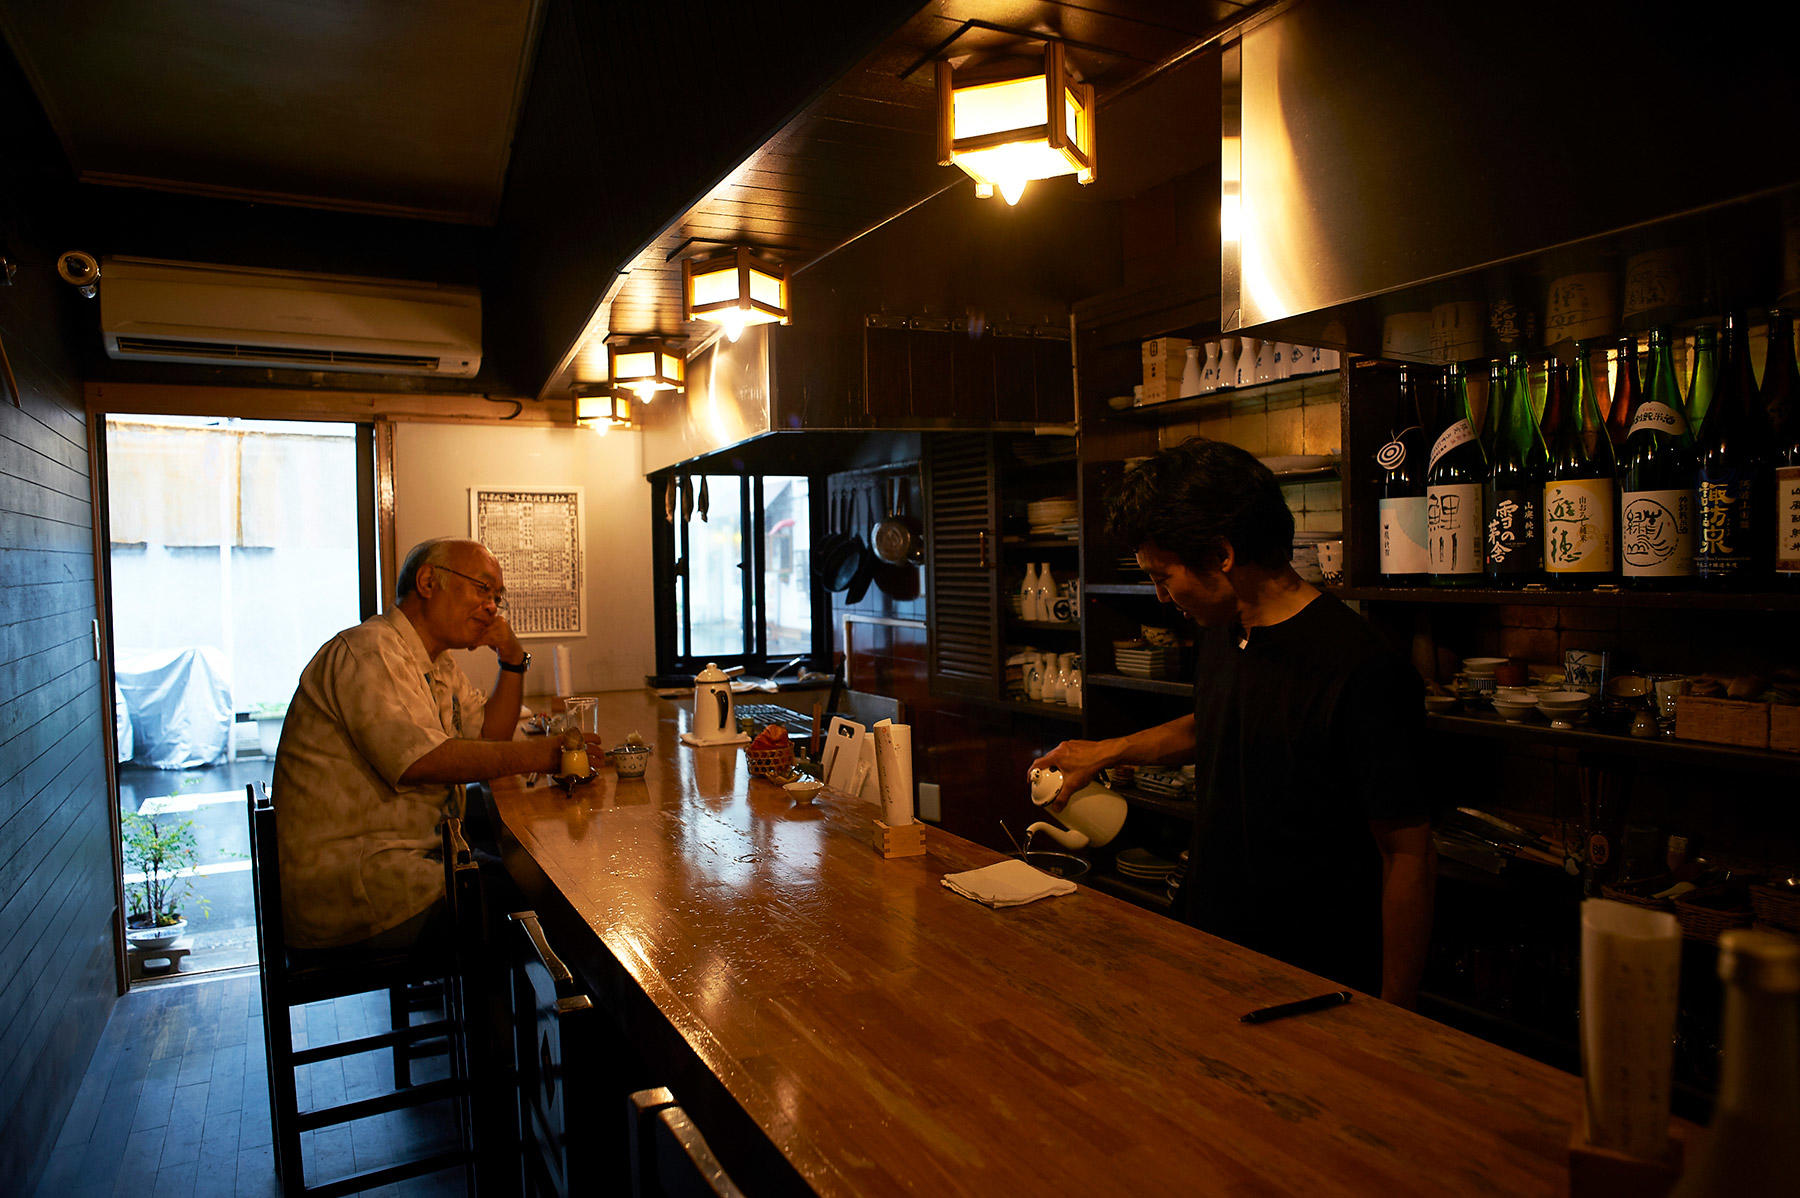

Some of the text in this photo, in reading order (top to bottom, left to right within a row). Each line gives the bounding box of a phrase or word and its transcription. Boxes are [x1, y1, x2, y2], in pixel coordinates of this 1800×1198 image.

[1488, 499, 1519, 563] 雪の茅舎
[1698, 480, 1737, 555] 諏訪泉
